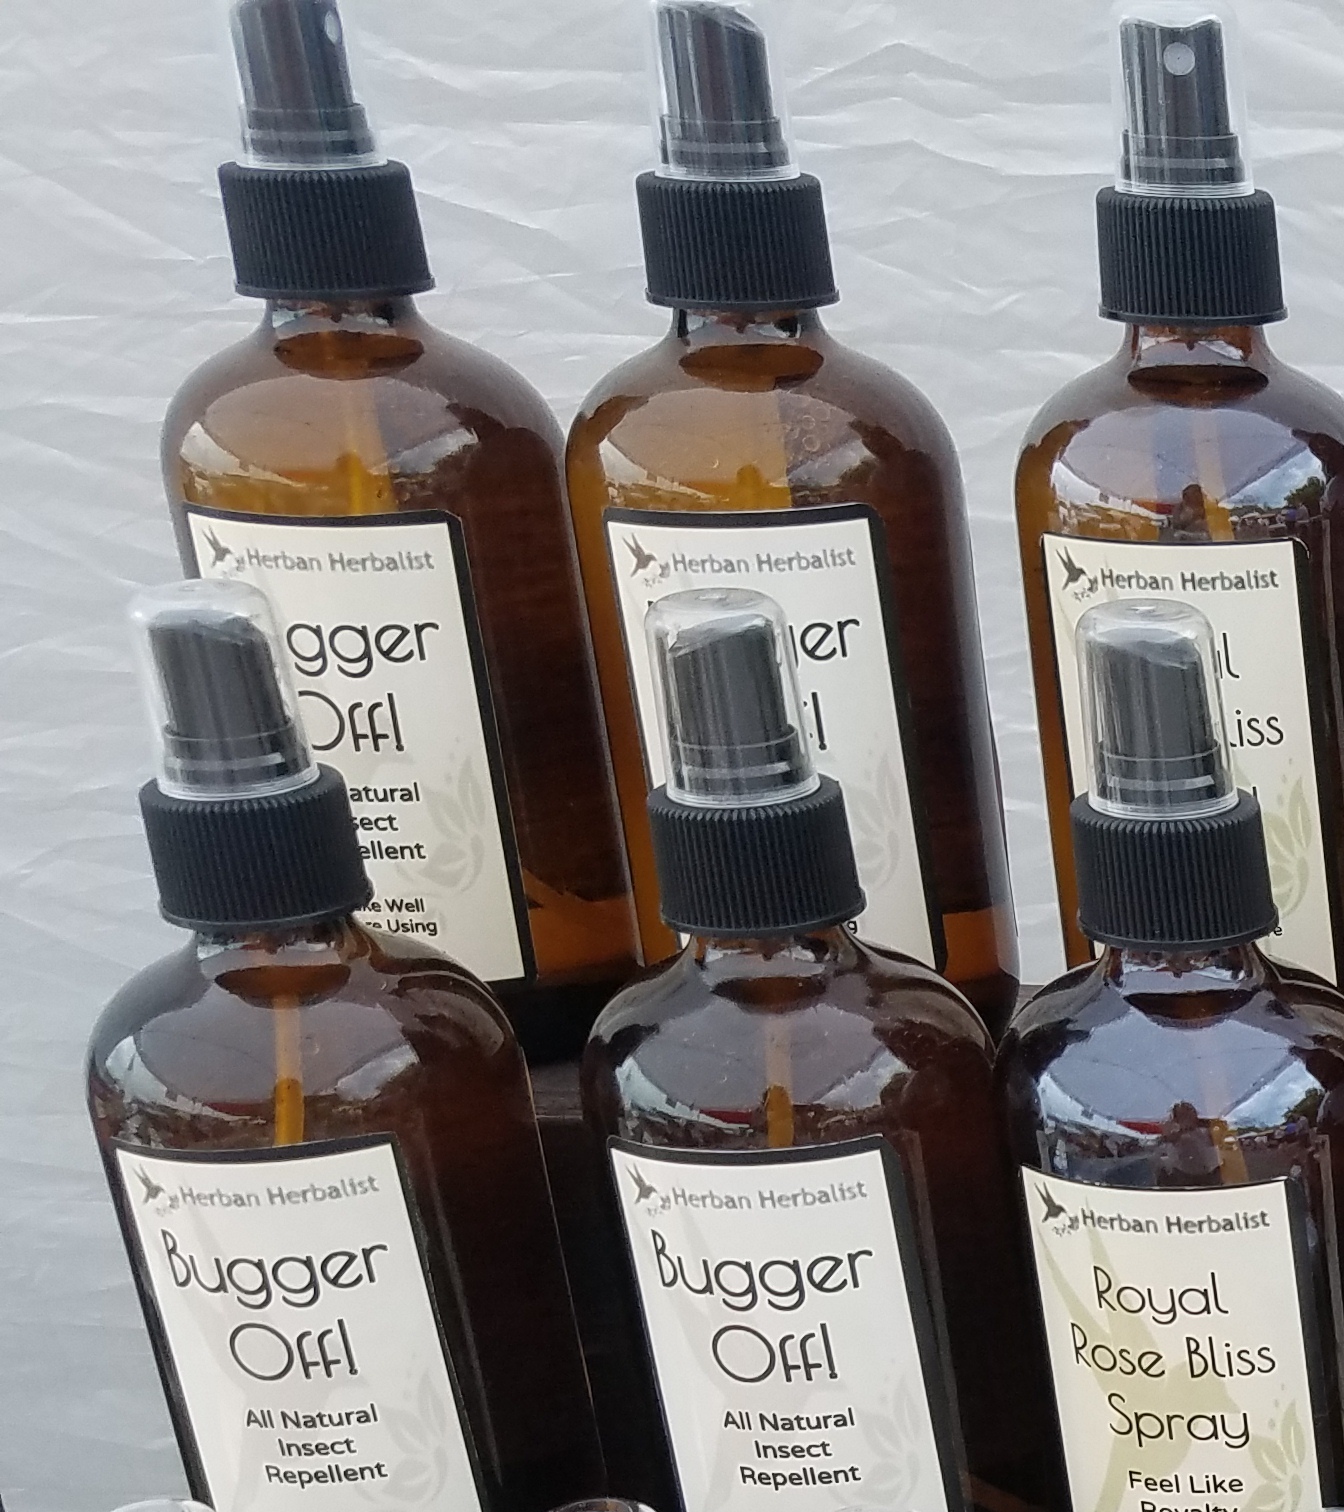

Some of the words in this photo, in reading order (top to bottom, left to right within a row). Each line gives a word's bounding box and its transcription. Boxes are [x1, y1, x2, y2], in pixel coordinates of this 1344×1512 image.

[246, 549, 321, 571] Herban
[329, 550, 434, 573] Herbalist
[672, 553, 749, 573] Herban
[756, 549, 855, 573] Herbalist
[1101, 569, 1173, 590] Herban
[1181, 570, 1278, 592] Herbalist
[180, 1185, 259, 1208] Herban
[267, 1174, 379, 1206] Herbalist
[1081, 1209, 1158, 1233] Herban
[1165, 1209, 1270, 1233] Herbalist
[161, 1229, 388, 1309] Bugger
[651, 1229, 873, 1311] Bugger
[1093, 1266, 1229, 1325] Royal
[230, 1318, 359, 1381] Off!
[712, 1322, 838, 1383] Off!
[1070, 1322, 1166, 1378] Rose
[1186, 1336, 1276, 1379] Bliss
[246, 1409, 274, 1429] All
[281, 1403, 378, 1429] Natural
[1107, 1392, 1250, 1448] Spray
[278, 1438, 356, 1458] Insect
[265, 1461, 388, 1489] Repellent
[1129, 1471, 1179, 1494] Feel
[1190, 1474, 1243, 1494] Like
